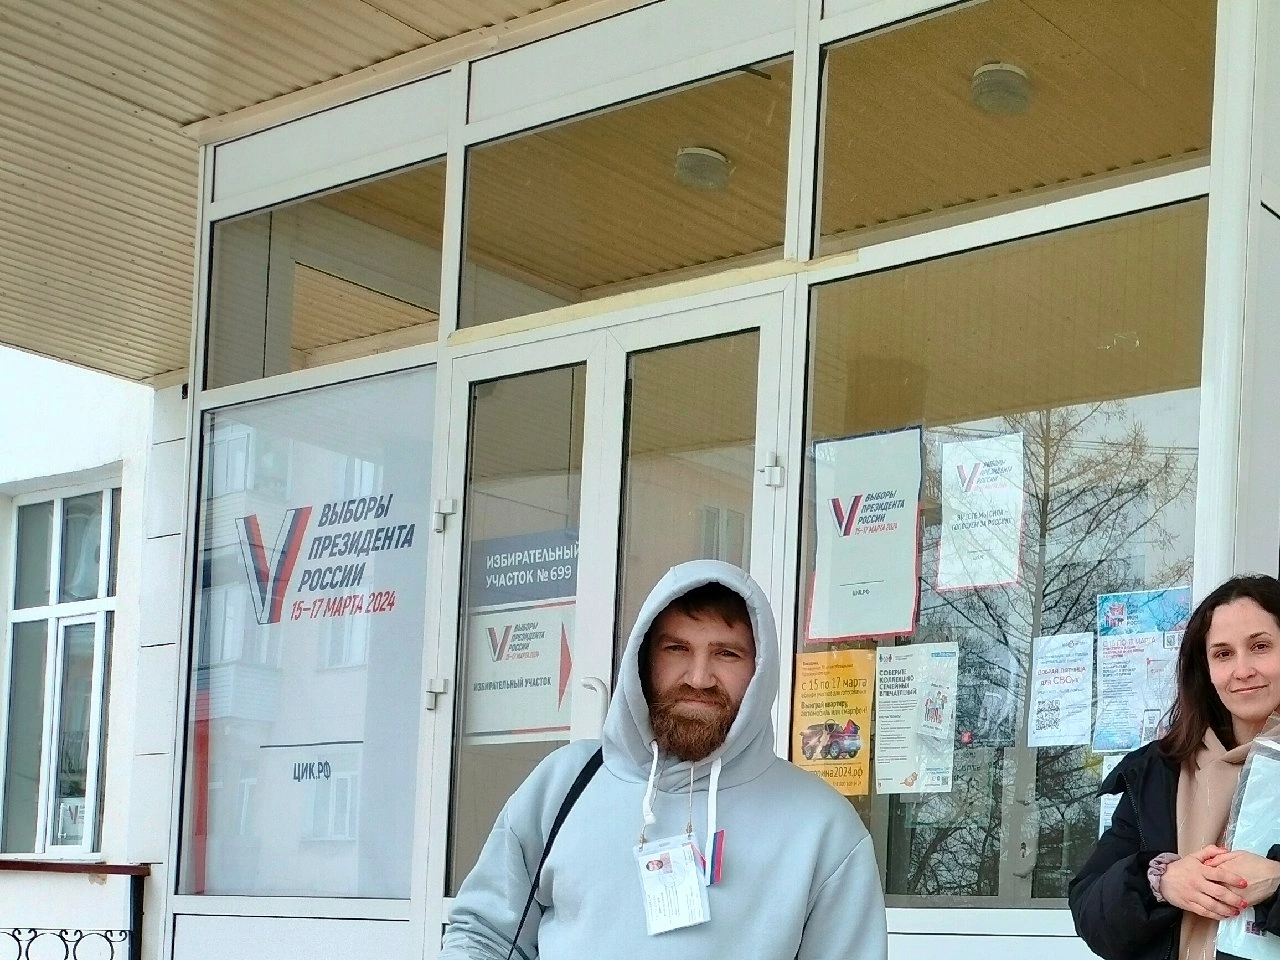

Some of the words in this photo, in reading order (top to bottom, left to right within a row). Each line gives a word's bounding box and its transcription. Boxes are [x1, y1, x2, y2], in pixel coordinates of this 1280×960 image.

[860, 499, 906, 513] ПРЕЗИДЕНТА
[864, 490, 898, 503] ВЫБОРЫ
[318, 493, 394, 527] ВЫБОРЫ
[857, 513, 886, 526] РОССИИ
[308, 523, 416, 560] ПРЕЗИДЕНТА
[486, 540, 579, 570] ИЗБИРАТЕЛЬНЫЙ
[297, 562, 367, 593] РОССИИ
[485, 569, 534, 589] УЧАСТОК
[550, 564, 572, 581] 699
[322, 594, 365, 618] МАРТА
[364, 590, 396, 614] 2024
[473, 676, 524, 693] ИЗБИРАТЕЛЬНЫЙ
[524, 676, 552, 688] УЧАСТОК
[809, 678, 819, 691] 15
[842, 678, 867, 691] марта
[293, 760, 332, 783] ЦИК.РФ
